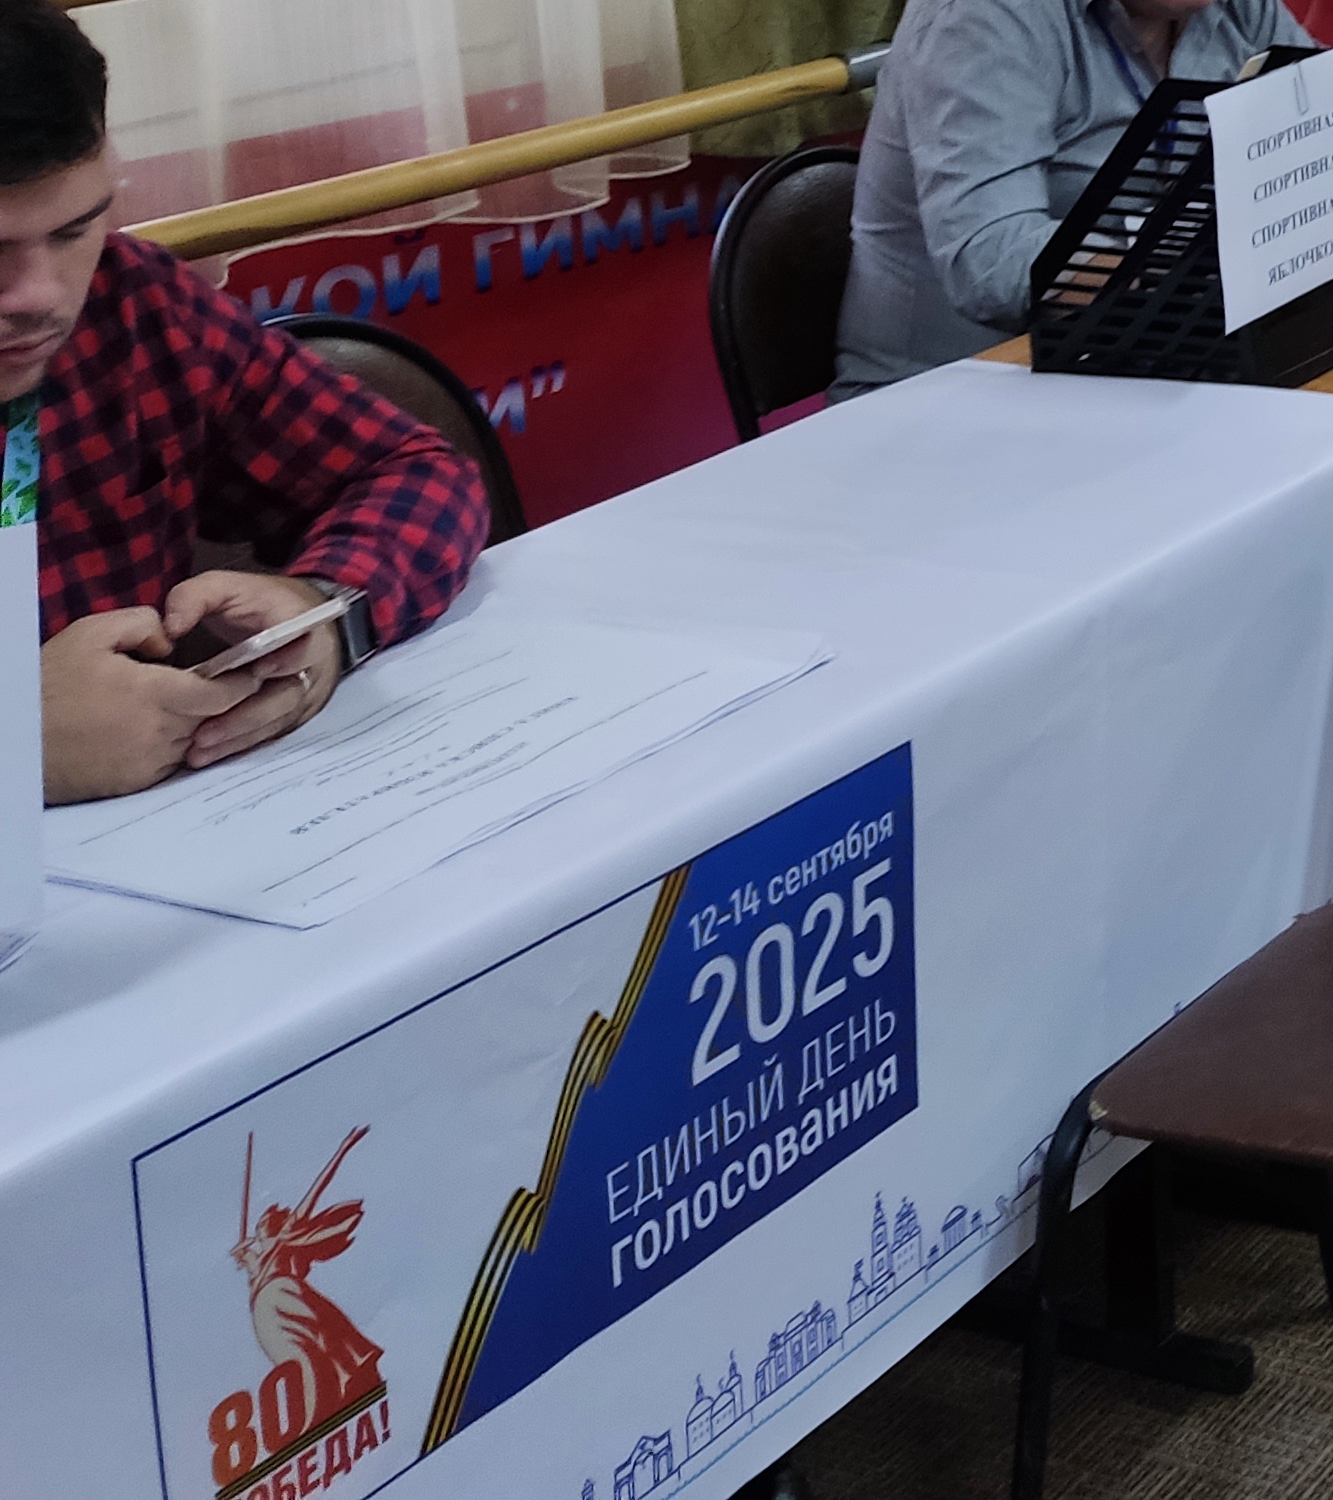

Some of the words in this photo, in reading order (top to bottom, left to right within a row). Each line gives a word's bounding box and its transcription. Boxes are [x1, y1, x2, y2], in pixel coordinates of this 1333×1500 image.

[685, 884, 762, 953] 12-14
[766, 809, 895, 911] сентября
[689, 859, 896, 1087] 2025
[605, 1055, 786, 1226] ЕДИНЫЙ
[797, 997, 896, 1110] ДЕНЬ
[207, 1358, 307, 1488] 80
